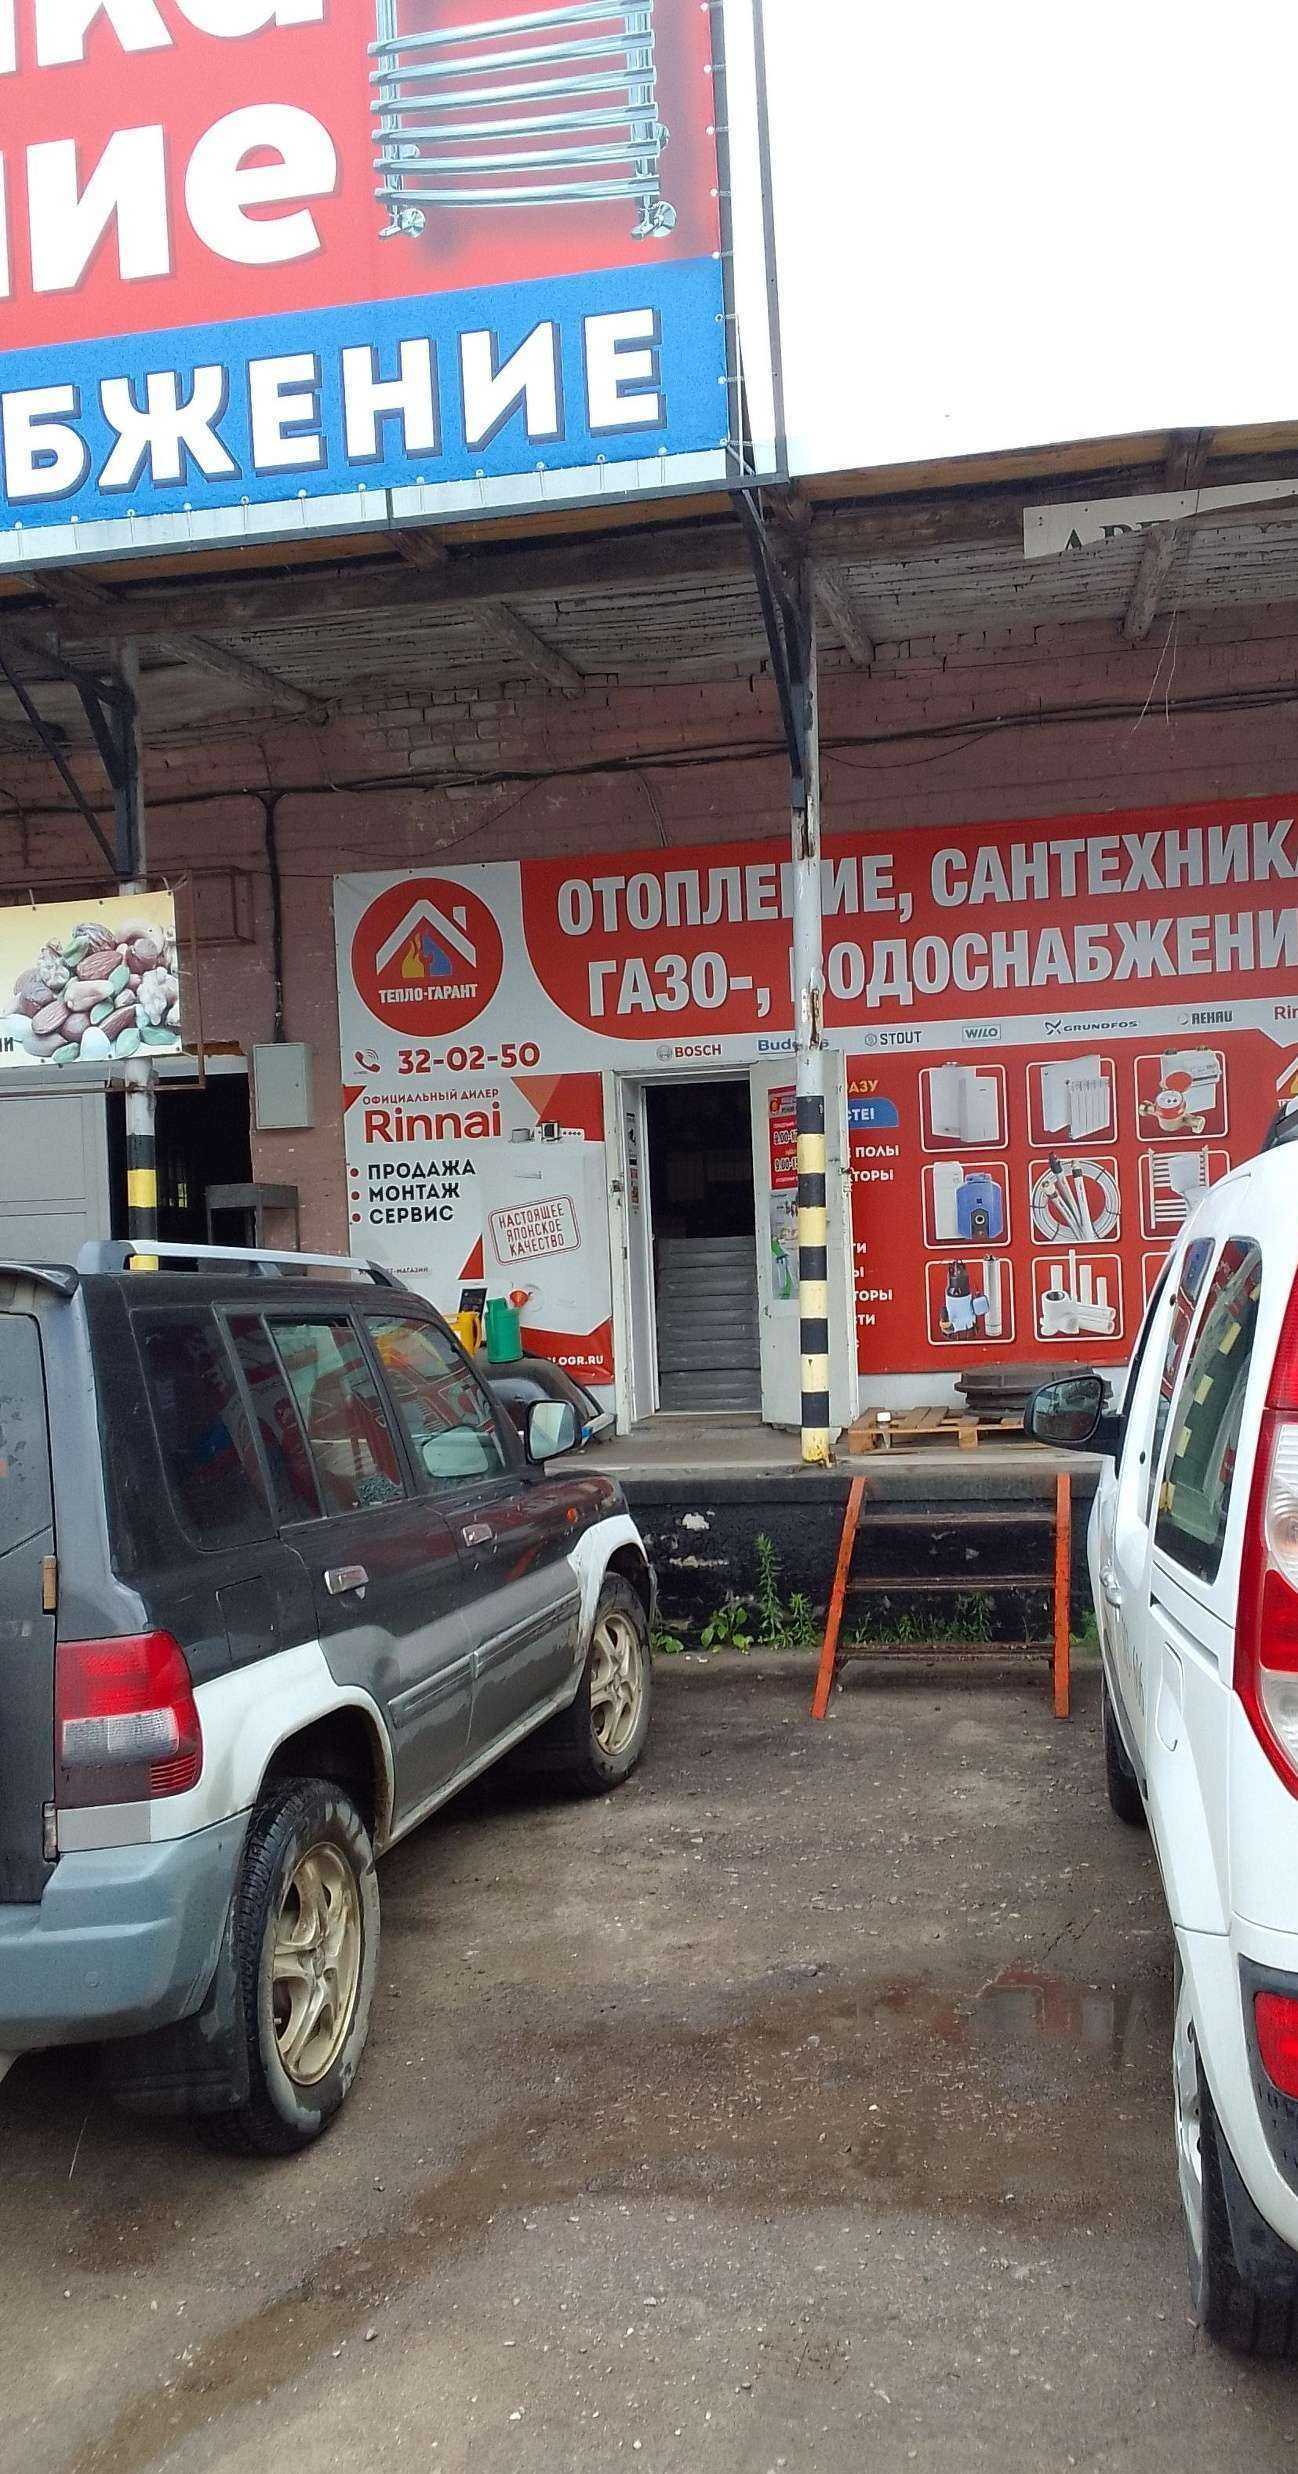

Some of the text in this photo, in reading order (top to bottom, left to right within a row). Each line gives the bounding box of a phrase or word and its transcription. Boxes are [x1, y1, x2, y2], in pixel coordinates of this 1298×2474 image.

[1, 307, 664, 505] БЖЕНИЕ
[931, 819, 1298, 907] САНТЕХНИК
[588, 908, 1298, 1018] ГАЗО-, ОДОСНАБЖЕНИ
[378, 983, 478, 1004] ТЕПЛО-ГАРАНТ
[1063, 1020, 1138, 1032] GRUNDFOS
[1191, 1010, 1233, 1025] REHAU
[880, 1030, 923, 1046] STOUT
[965, 1027, 998, 1040] WILO
[397, 1042, 541, 1075] 32-02-50
[675, 1044, 722, 1058] BOSCH
[362, 1088, 500, 1105] ОФИЦИАЛЬНЫЙ ДИЛЕР
[364, 1101, 502, 1144] Rinnai
[855, 1144, 900, 1158] ПОЛЫ
[367, 1158, 477, 1181] ПРОДАЖА
[368, 1181, 461, 1203] МОНТАЖ
[369, 1205, 454, 1225] СЕРВИС
[498, 1201, 565, 1228] НАСТОЯЩЕЕ
[506, 1219, 562, 1242] ЯПОНСКОЕ
[510, 1232, 565, 1258] КАЧЕСТВО
